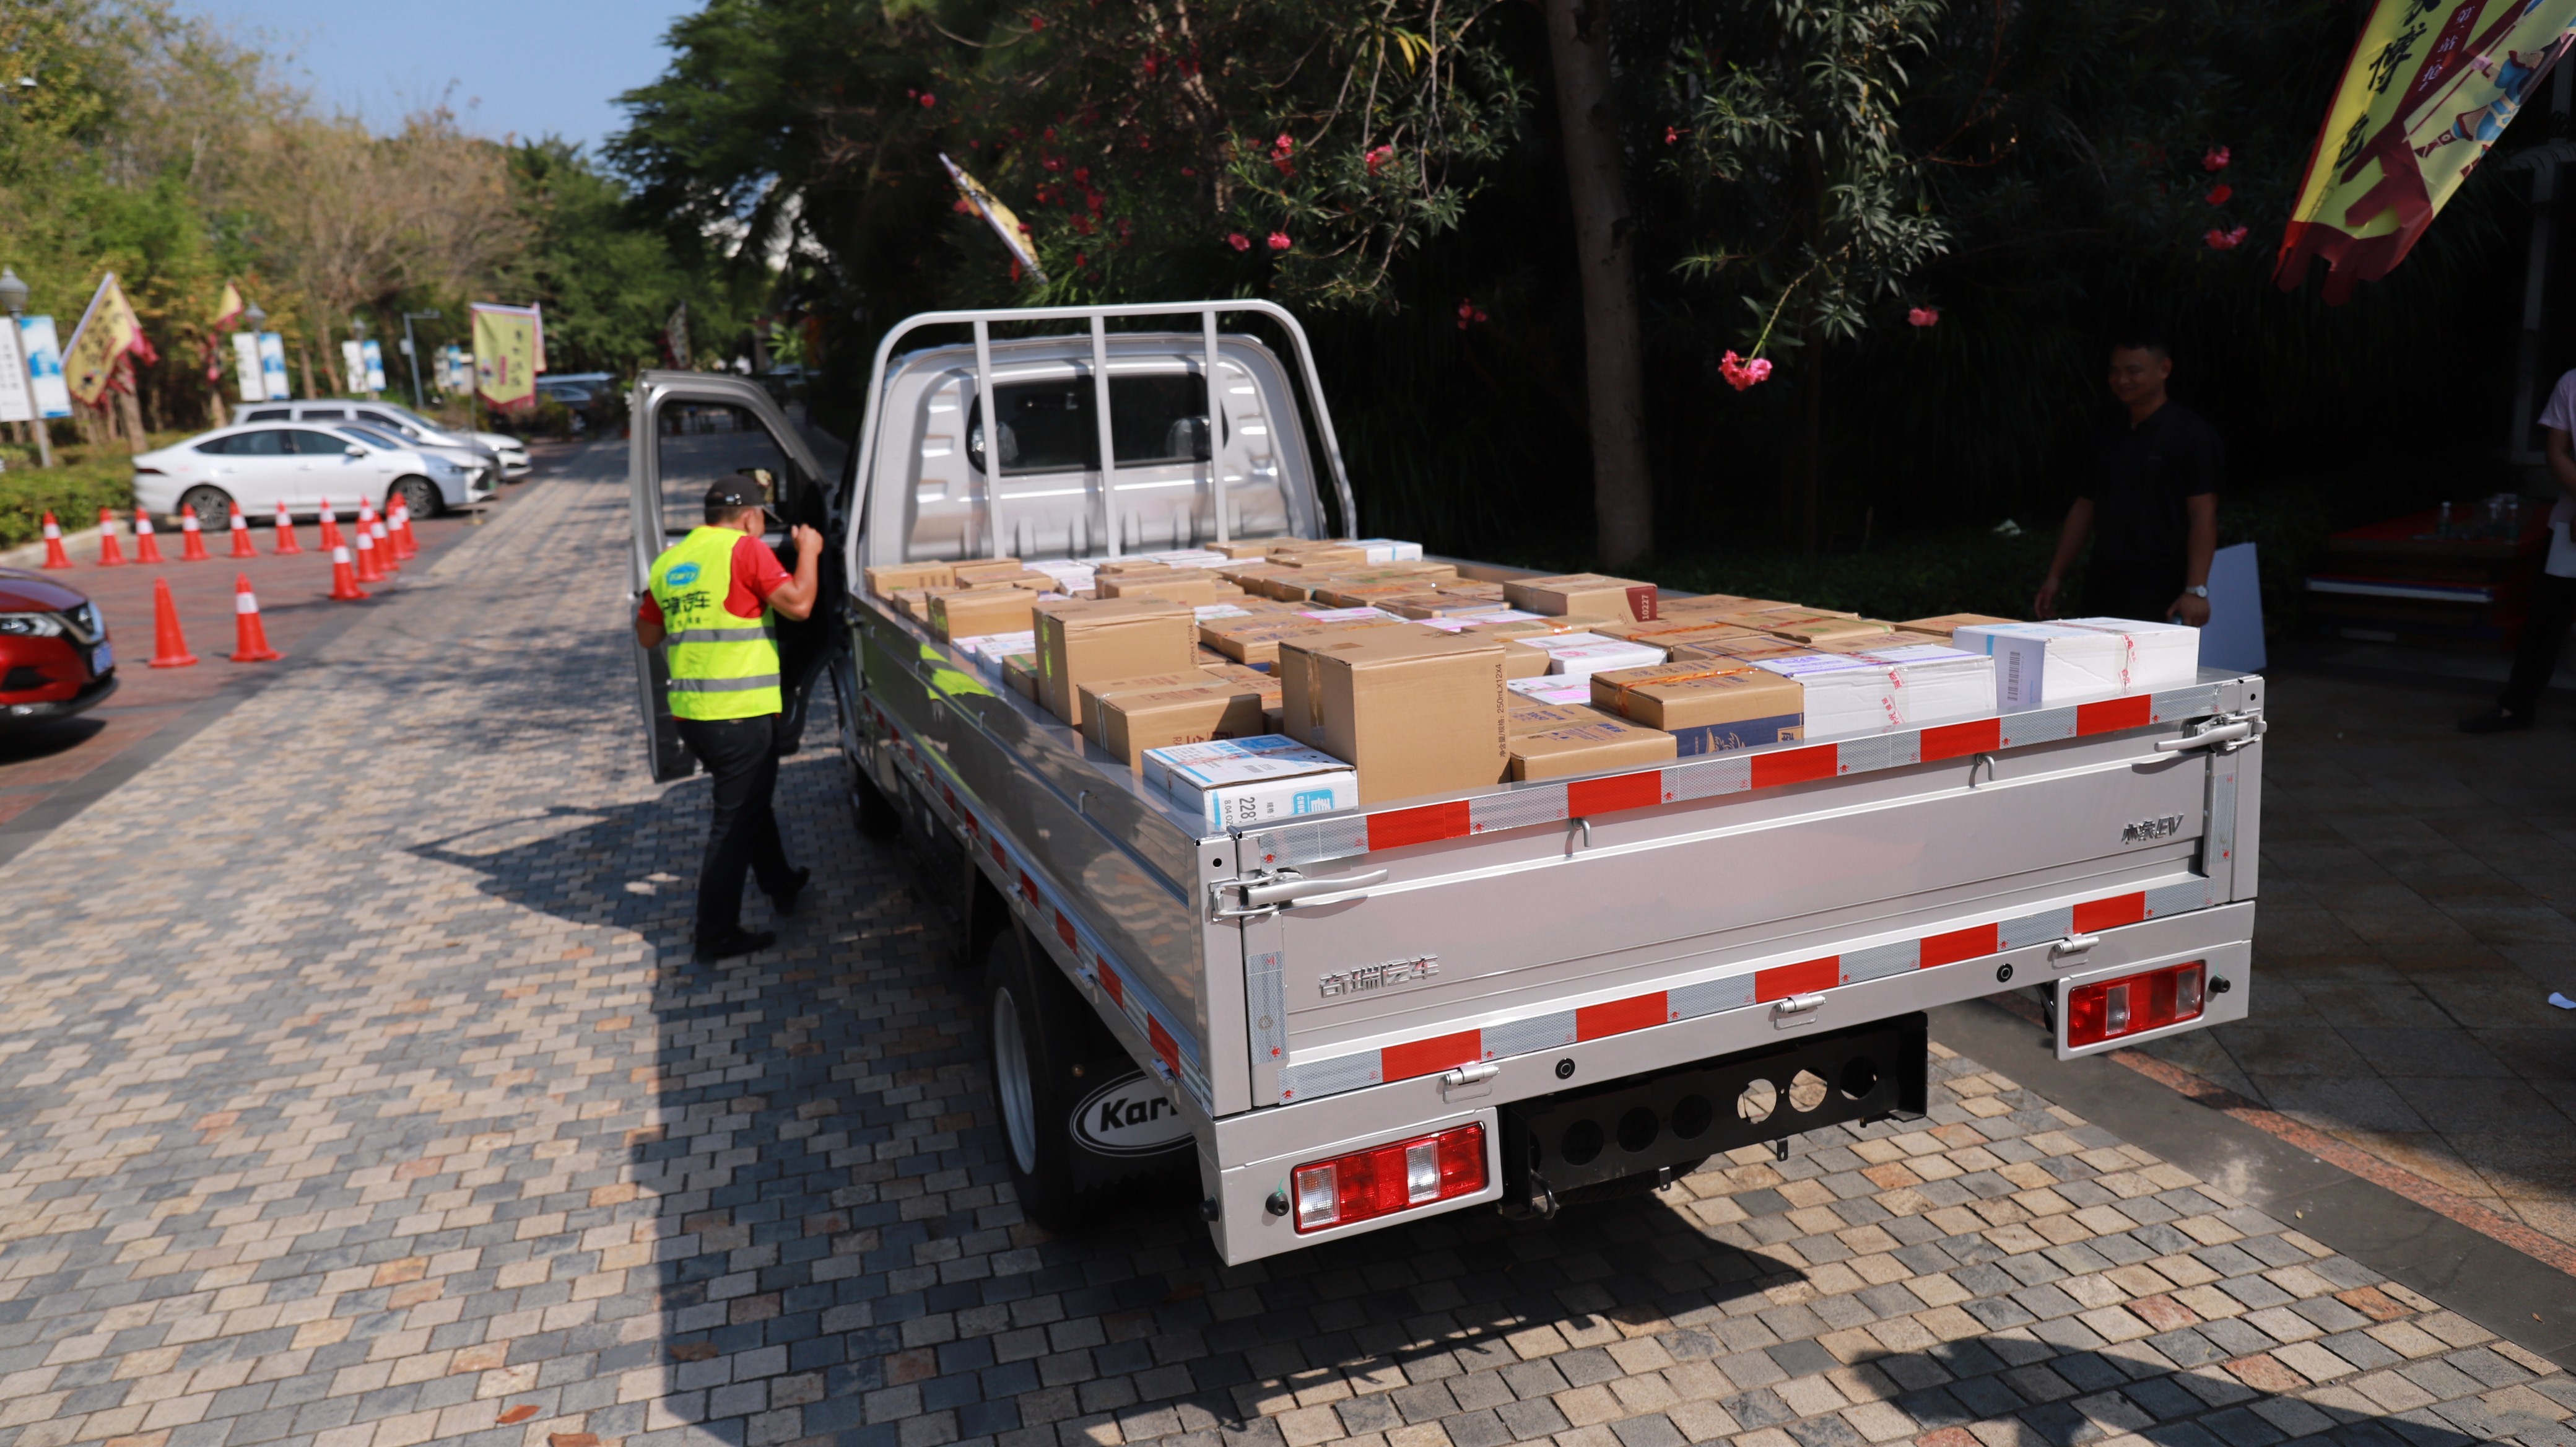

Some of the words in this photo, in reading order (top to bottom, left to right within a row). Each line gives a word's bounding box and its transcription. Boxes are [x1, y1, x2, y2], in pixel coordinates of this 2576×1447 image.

[1641, 594, 1650, 620] 10227
[1239, 797, 1257, 823] 228
[1100, 1096, 1178, 1132] Kar
